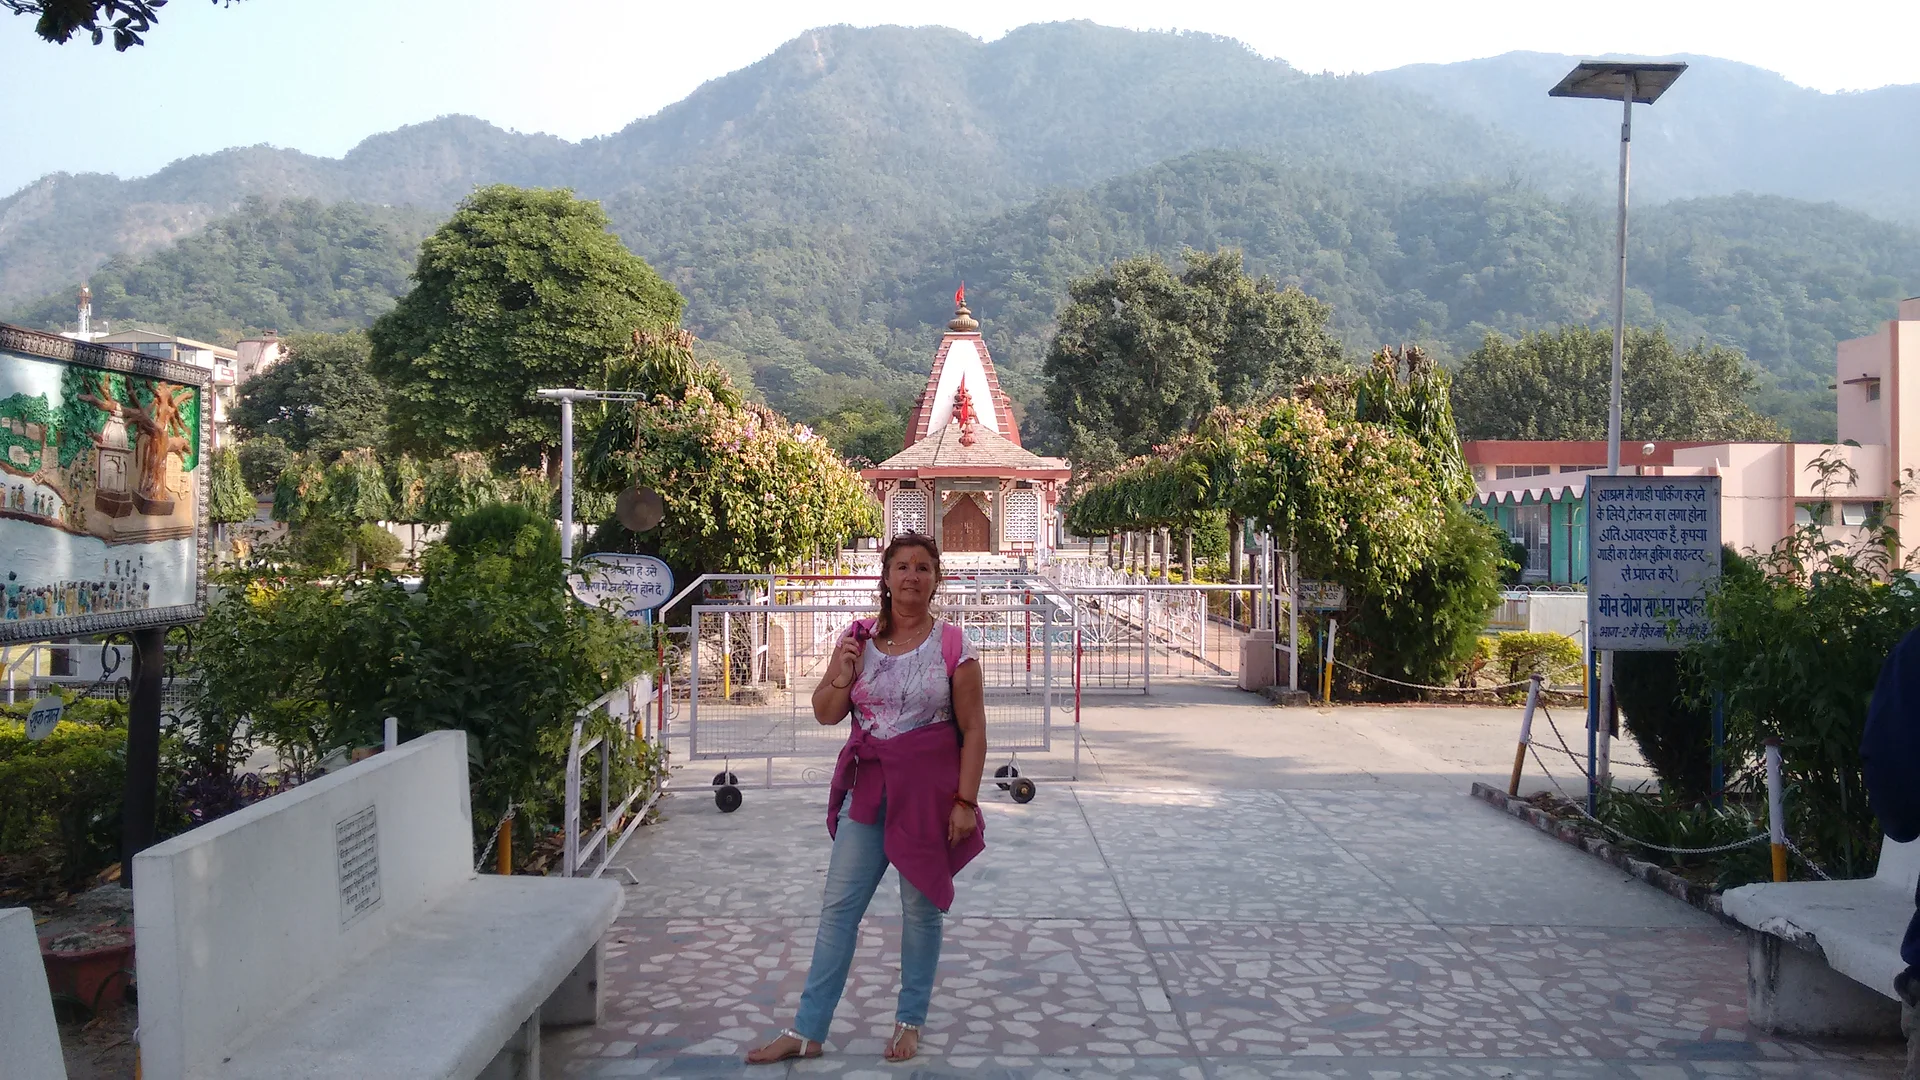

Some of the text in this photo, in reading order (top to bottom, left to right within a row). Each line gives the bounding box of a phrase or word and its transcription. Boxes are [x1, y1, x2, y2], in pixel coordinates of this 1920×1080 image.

[1597, 488, 1625, 502] आश्रम
[1684, 485, 1706, 502] करने
[1596, 505, 1605, 521] के
[1628, 505, 1652, 521] टोकन
[1654, 509, 1666, 521] का
[1667, 509, 1687, 521] लगा
[1688, 505, 1707, 523] होना
[1599, 525, 1620, 542] अति
[1621, 529, 1668, 542] आवश्यक
[1680, 529, 1707, 545] कृपया
[1617, 549, 1628, 560] का
[1629, 545, 1649, 560] टोकन
[645, 564, 657, 577] उसे
[1621, 564, 1631, 582] से
[1633, 568, 1656, 581] प्राप्त
[640, 581, 654, 598] होने
[1598, 593, 1618, 617] मौन
[1620, 593, 1642, 617] योग
